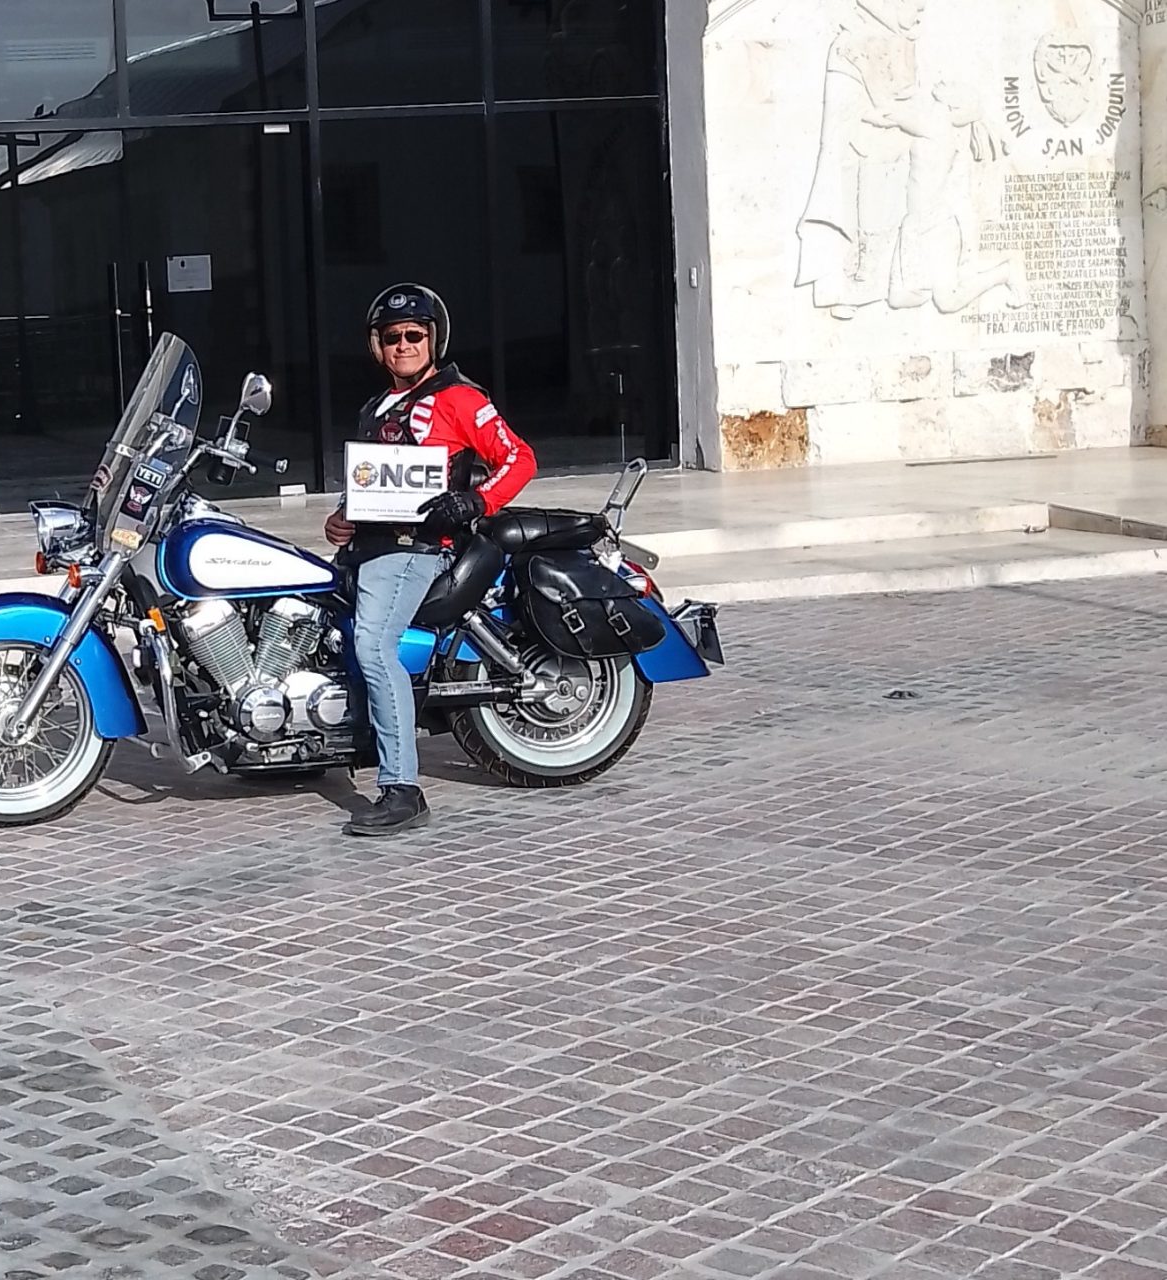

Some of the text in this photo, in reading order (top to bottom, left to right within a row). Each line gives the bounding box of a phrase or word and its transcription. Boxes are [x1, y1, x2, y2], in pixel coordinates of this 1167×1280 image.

[1003, 72, 1128, 157] MISIÓN SAN JOAQUÍN
[137, 466, 163, 485] YETI
